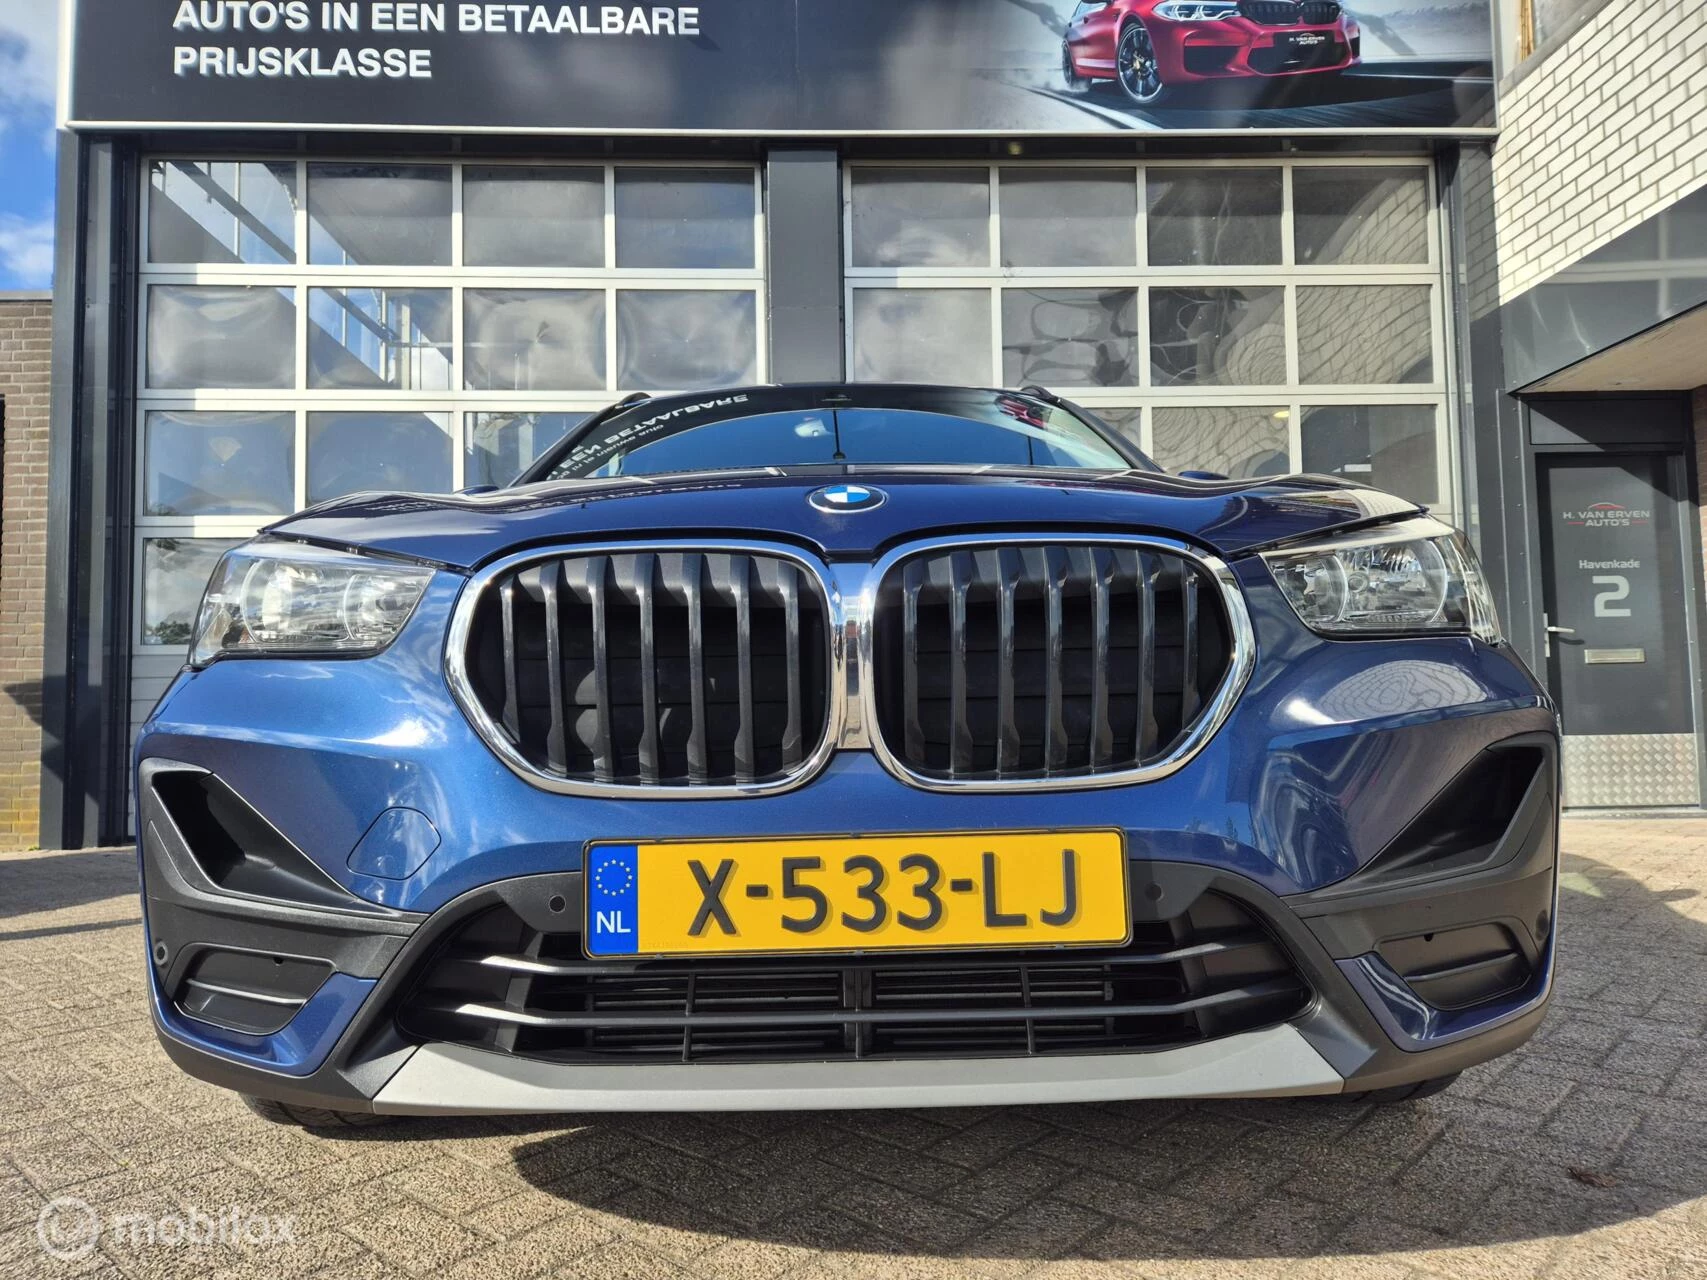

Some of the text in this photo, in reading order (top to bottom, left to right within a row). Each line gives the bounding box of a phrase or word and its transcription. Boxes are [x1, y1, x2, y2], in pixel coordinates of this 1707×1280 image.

[172, 0, 700, 36] AUTO'S IN EEN BETAALBARE
[173, 46, 432, 78] PRIJSKLASSE
[1563, 510, 1650, 519] H. VAN ERVEN
[1585, 519, 1630, 527] AUTO'S
[1579, 559, 1641, 569] Havenkade
[1592, 575, 1632, 618] 2
[687, 849, 1080, 936] X-533-LJ
[596, 910, 632, 934] NL
